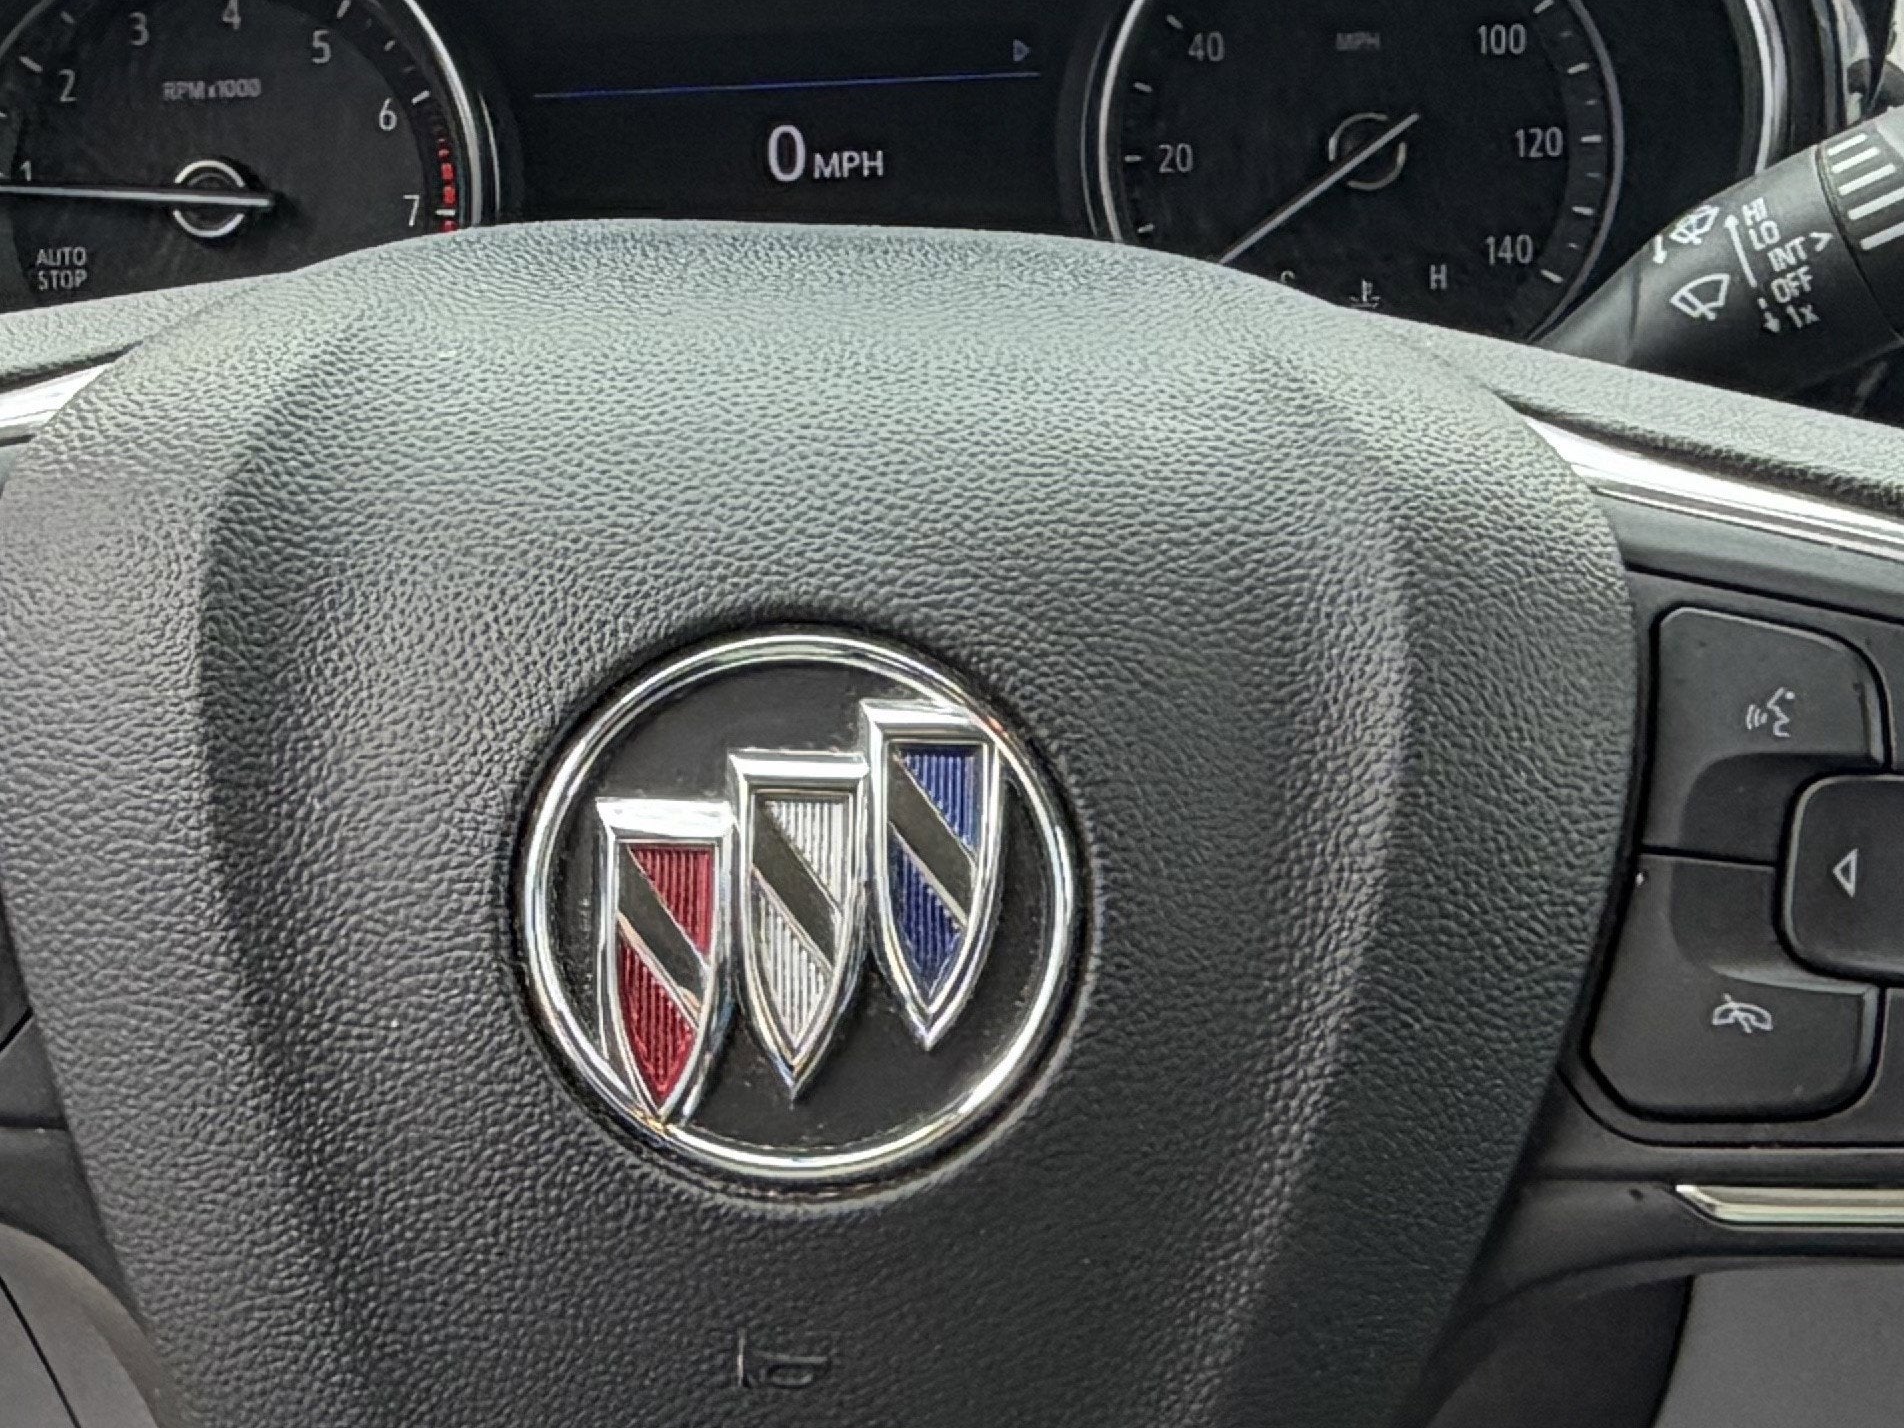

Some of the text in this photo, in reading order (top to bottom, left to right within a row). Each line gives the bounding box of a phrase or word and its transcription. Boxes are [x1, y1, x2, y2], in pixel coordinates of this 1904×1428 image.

[129, 12, 150, 47] 3
[1187, 30, 1226, 63] 40
[1477, 23, 1527, 57] 100
[311, 29, 333, 65] 5
[58, 68, 78, 103] 2
[378, 97, 399, 131] 6
[767, 124, 885, 183] 0 MPH
[1157, 143, 1195, 175] 20
[1515, 126, 1564, 159] 120
[402, 194, 421, 229] 7
[1485, 233, 1534, 265] 140
[1748, 220, 1782, 250] LO
[35, 247, 88, 270] AUTO
[1767, 235, 1808, 272] INT
[37, 270, 89, 291] STOP
[1429, 263, 1447, 290] H
[1770, 264, 1814, 303] OFF
